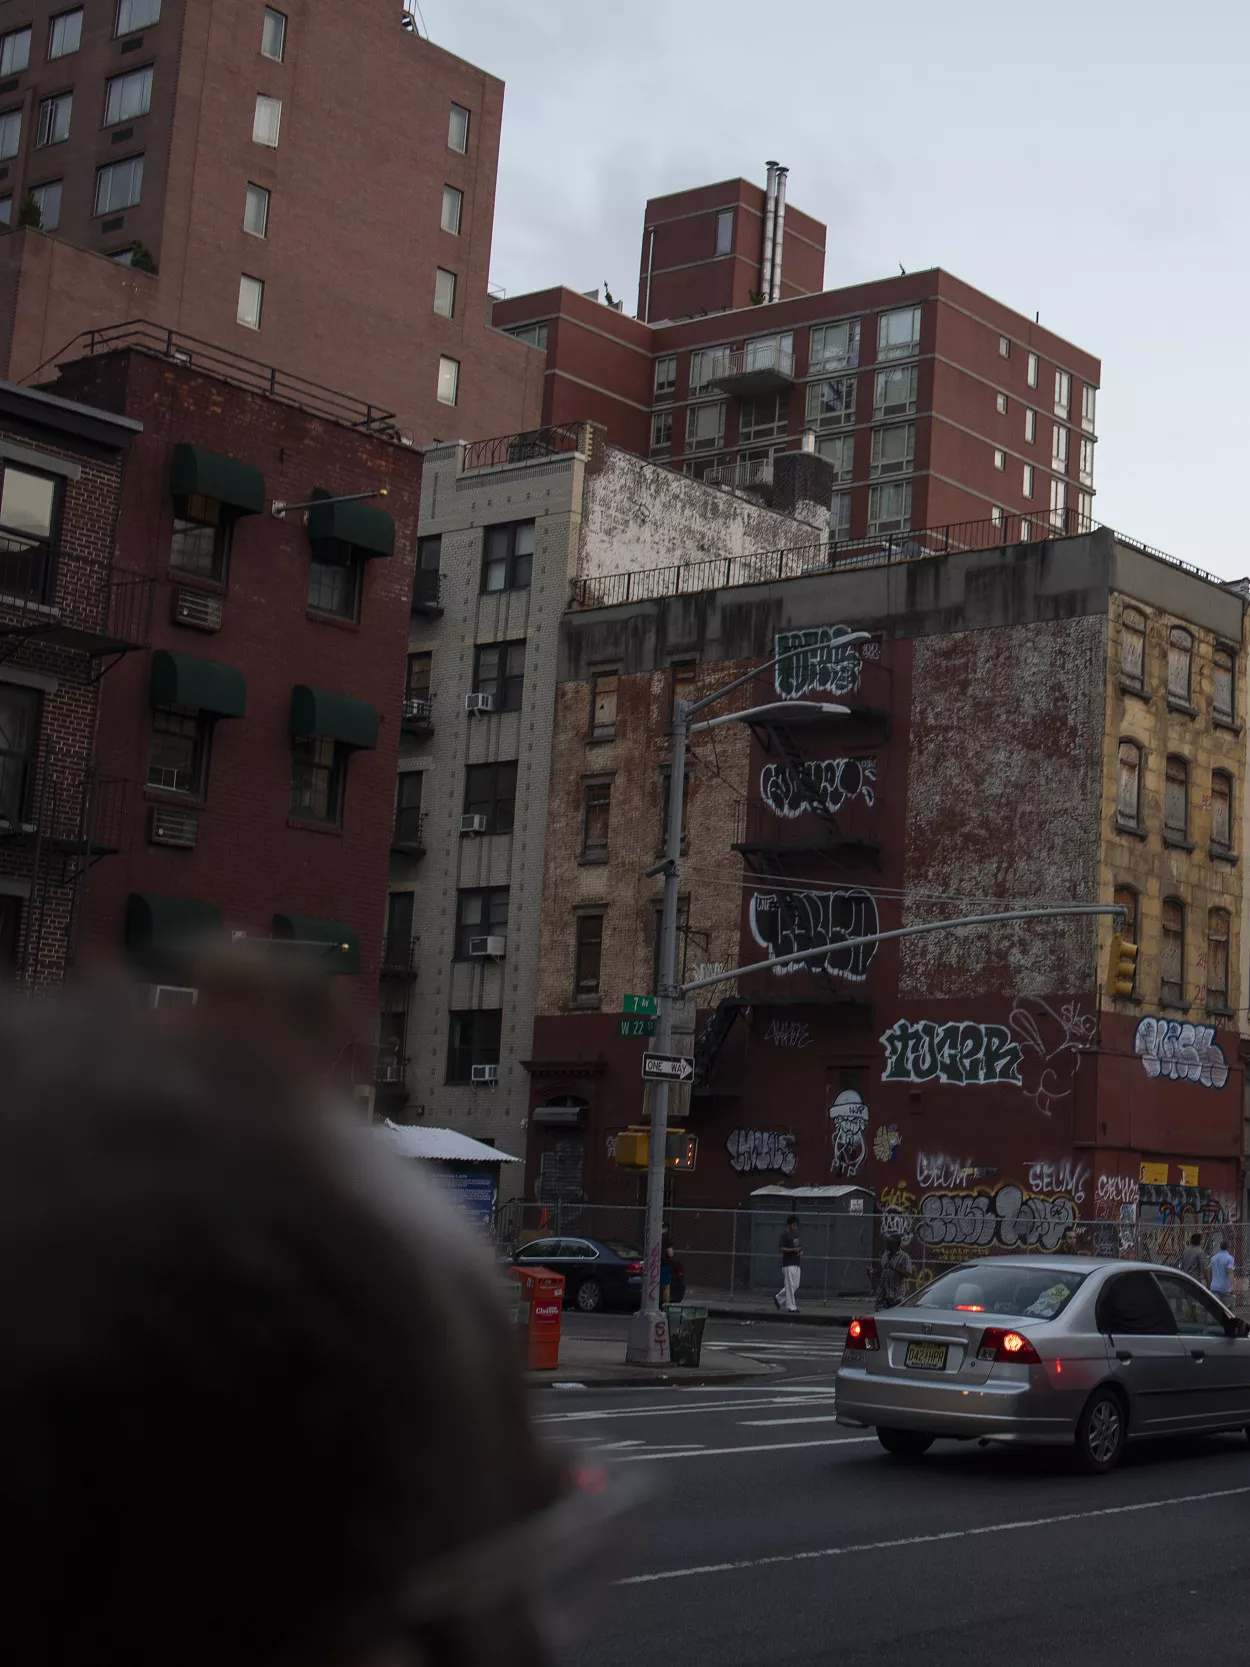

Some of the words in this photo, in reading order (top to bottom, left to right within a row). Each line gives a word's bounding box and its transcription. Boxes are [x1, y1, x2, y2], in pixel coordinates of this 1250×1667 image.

[633, 997, 639, 1012] 7
[621, 1021, 630, 1035] W
[633, 1021, 644, 1035] 22
[647, 1061, 663, 1072] ONE
[671, 1062, 687, 1073] WAY
